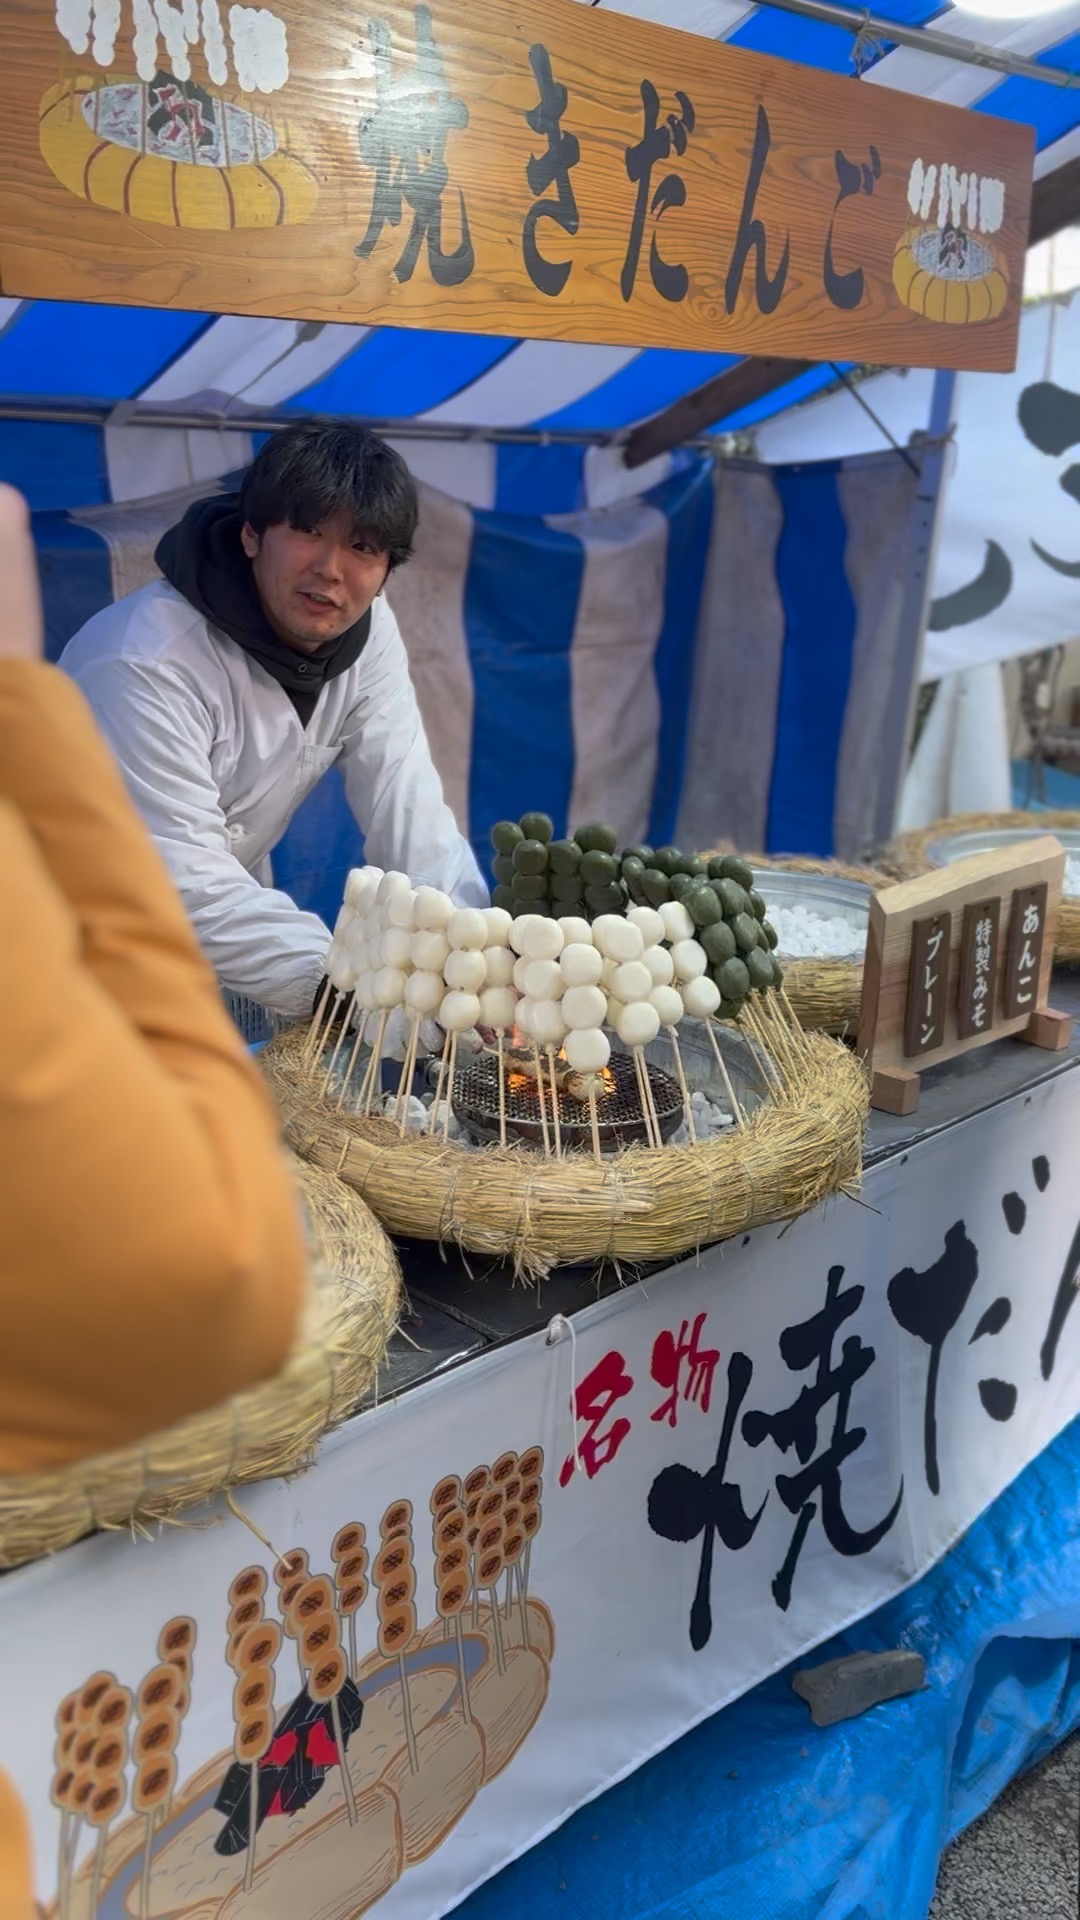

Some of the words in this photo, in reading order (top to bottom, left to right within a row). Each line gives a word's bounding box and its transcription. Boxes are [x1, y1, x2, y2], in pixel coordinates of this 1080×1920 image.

[353, 4, 881, 315] 焼きだんご
[971, 918, 992, 1027] 特製みそ
[1017, 904, 1039, 1003] あんこ
[559, 1313, 720, 1488] 名物
